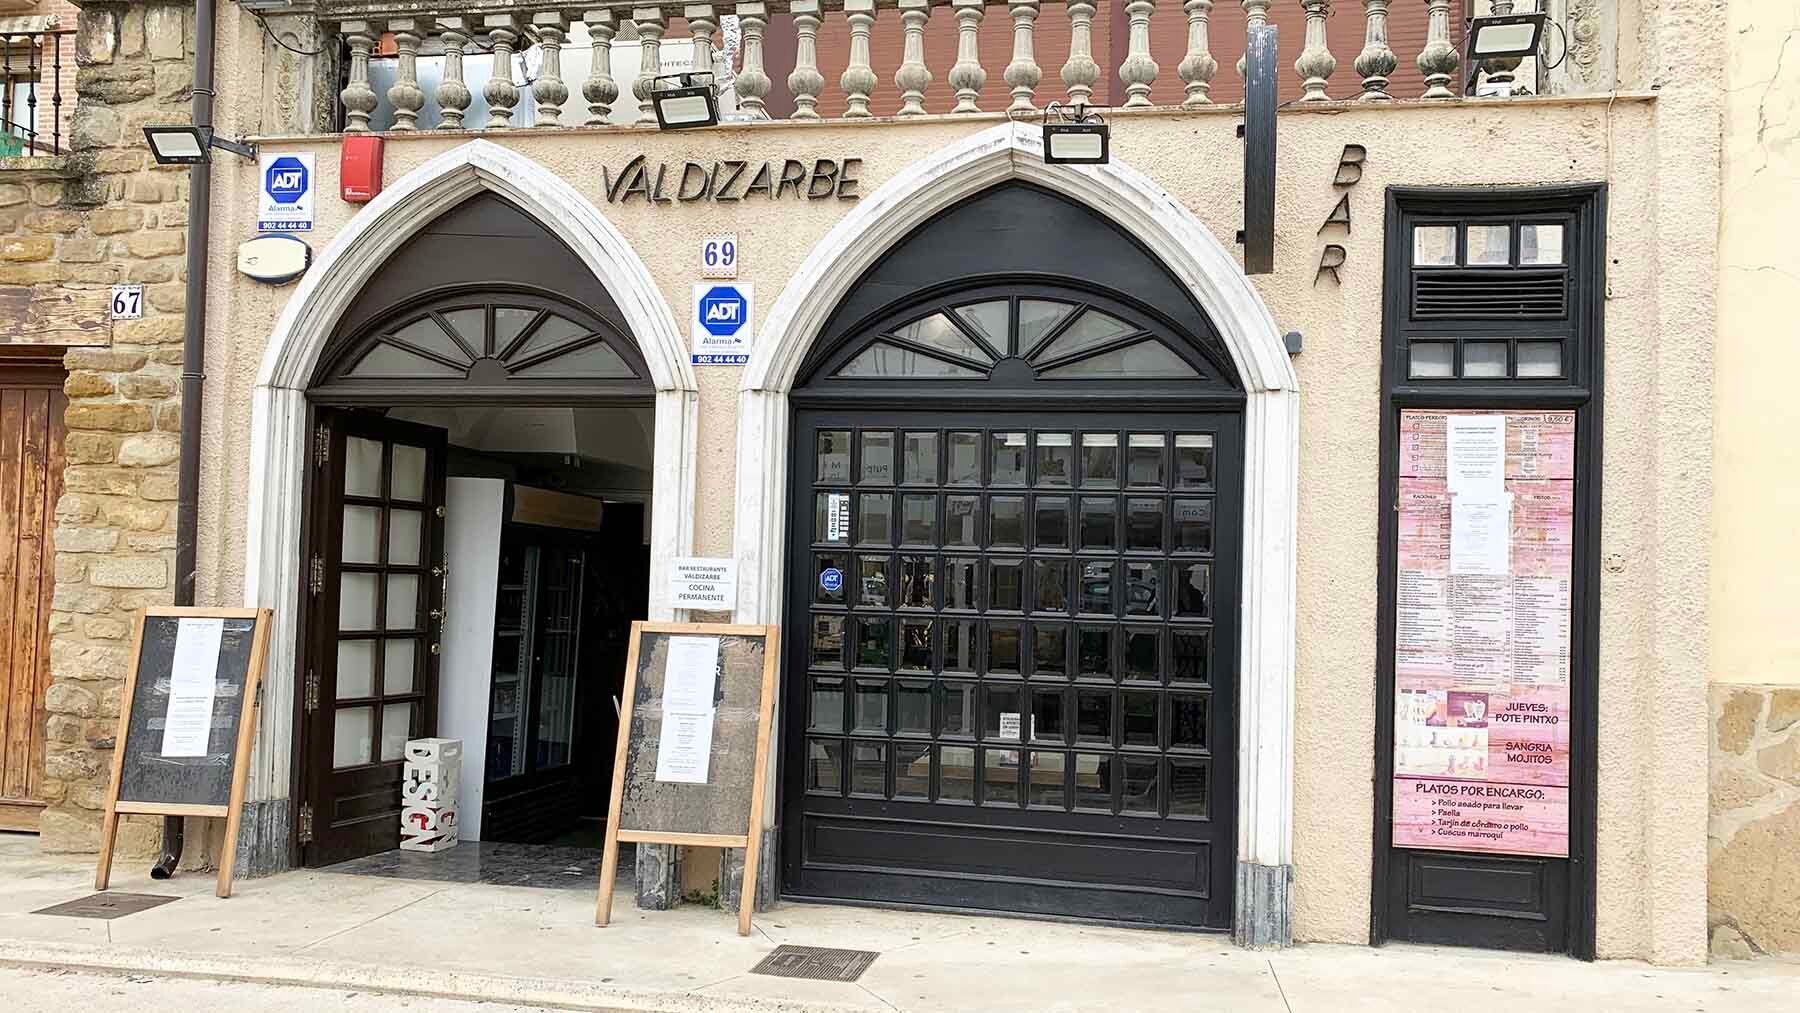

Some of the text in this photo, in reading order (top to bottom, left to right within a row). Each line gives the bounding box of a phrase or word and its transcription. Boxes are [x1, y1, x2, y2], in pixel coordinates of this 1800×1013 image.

[273, 172, 302, 188] ADT
[601, 154, 862, 204] VALDIZARBE
[1313, 144, 1367, 288] BAR
[705, 241, 735, 266] 69
[113, 291, 140, 314] 67
[707, 303, 739, 320] ADT
[702, 337, 732, 345] Alarma
[678, 593, 724, 602] PERMANENTE
[1506, 703, 1548, 712] JUEVES:
[1496, 713, 1559, 725] POTE PINTXO
[1505, 742, 1552, 752] SANGRIA
[1507, 754, 1552, 764] MOJITOS
[400, 741, 439, 852] DESIGN
[1416, 783, 1545, 800] PLATOS POR ENCARGO:
[1438, 799, 1524, 811] Pollo asado para llevar
[1438, 809, 1460, 817] Paella
[1510, 823, 1528, 832] pollo
[1468, 831, 1503, 840] marroquí
